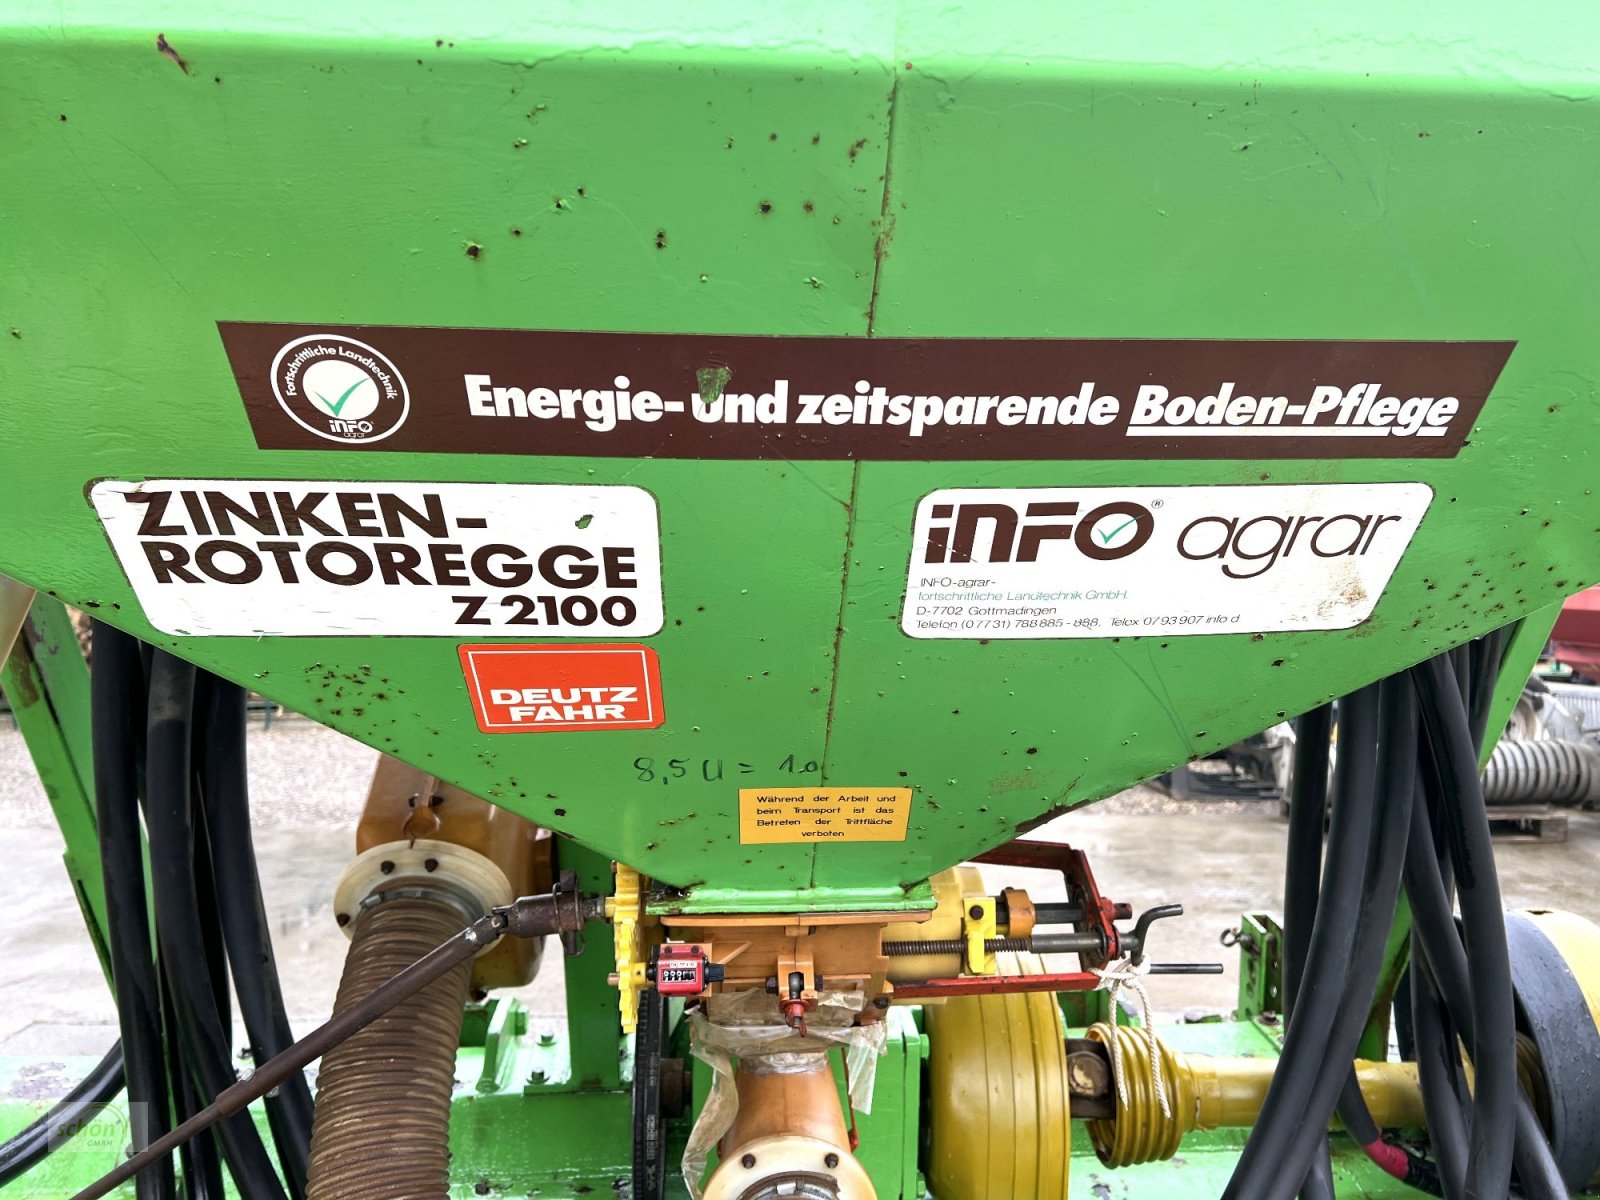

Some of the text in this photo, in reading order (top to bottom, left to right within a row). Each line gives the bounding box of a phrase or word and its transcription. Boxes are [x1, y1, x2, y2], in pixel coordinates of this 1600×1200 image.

[338, 346, 398, 400] Landtechnik
[464, 374, 1460, 437] Energie- und zeitsparende Boden-Pflege
[123, 491, 488, 538] ZINKEN-
[1176, 513, 1402, 579] agrar
[141, 540, 638, 588] ROTOREGGE
[451, 595, 638, 627] Z 2100
[916, 606, 1057, 617] D-7702 Gottmadingen
[917, 620, 957, 629] Telefon
[490, 687, 638, 705] DEUTZ
[509, 704, 626, 722] FAHR
[756, 795, 805, 803] Während
[793, 807, 841, 815] Transport
